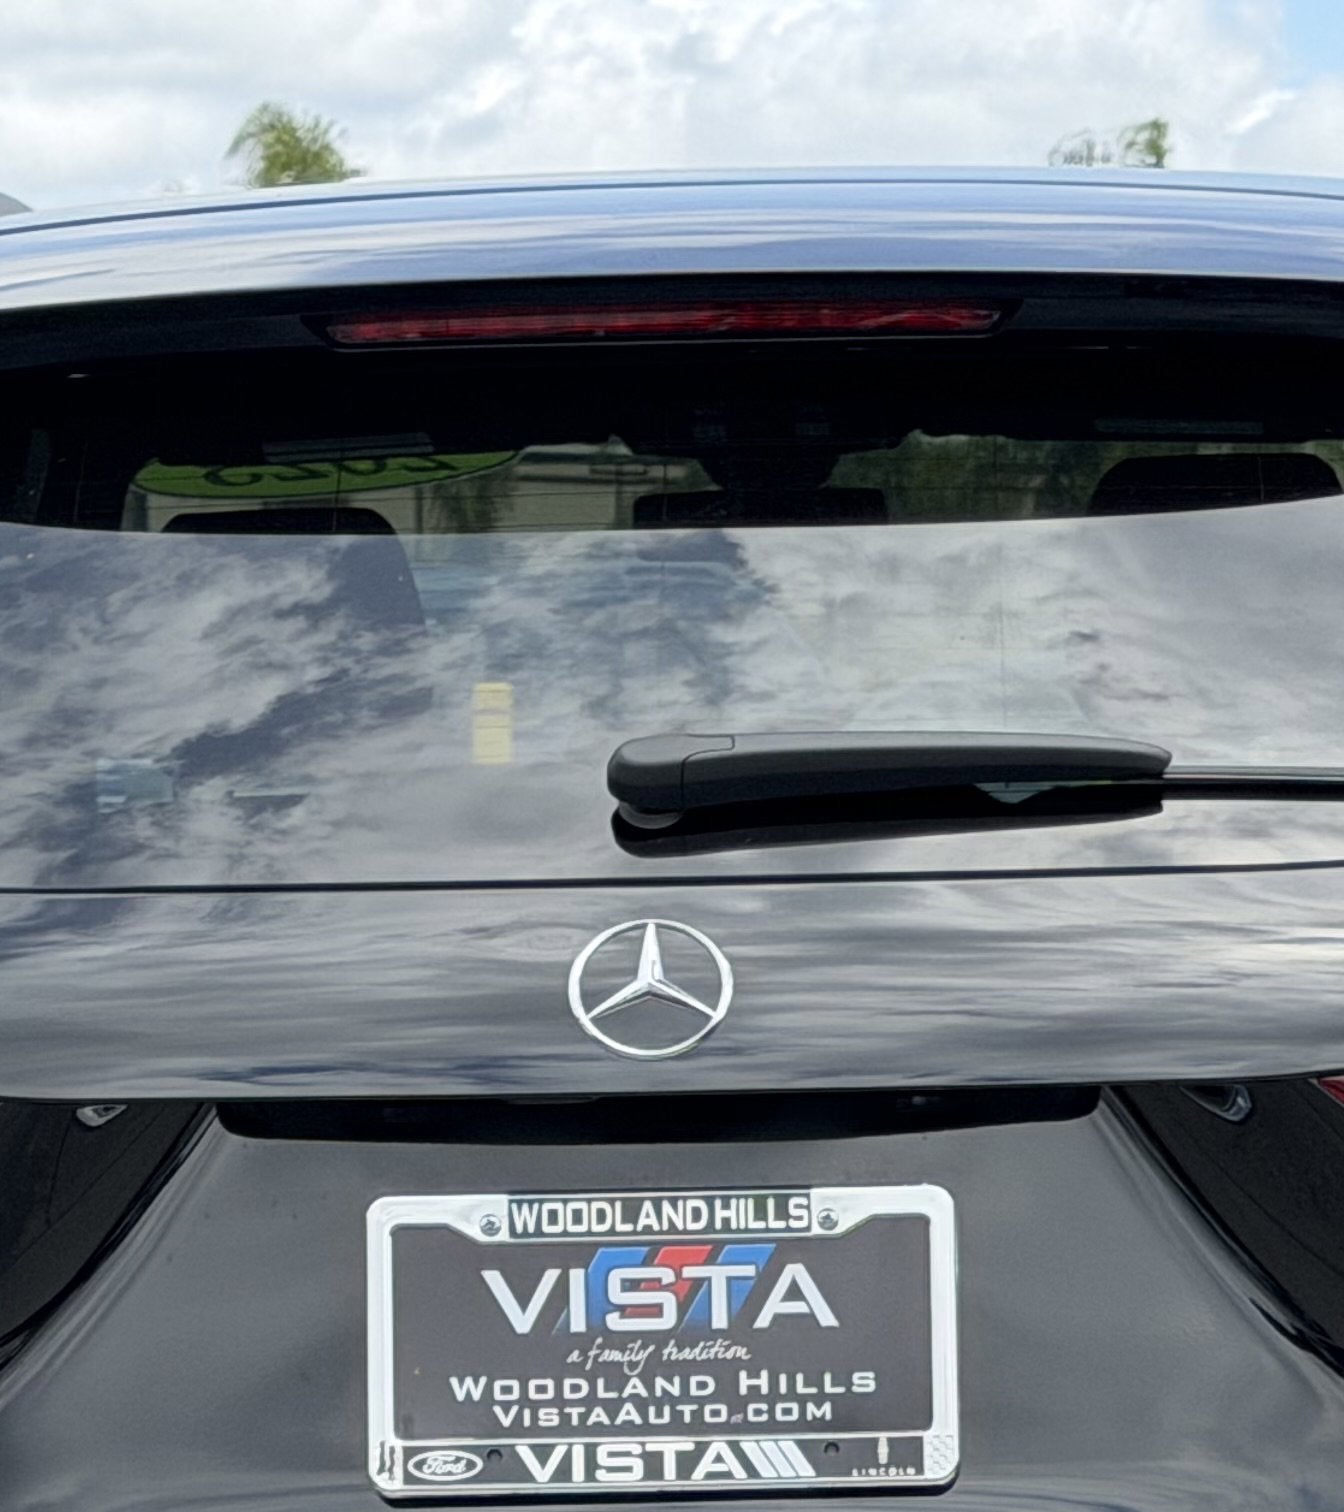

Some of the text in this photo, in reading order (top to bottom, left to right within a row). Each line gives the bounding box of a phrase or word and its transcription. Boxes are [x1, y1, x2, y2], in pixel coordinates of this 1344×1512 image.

[510, 1196, 809, 1235] WOODLAND HILLS
[480, 1263, 840, 1335] VISTA
[565, 1336, 753, 1377] a family tradition
[449, 1369, 877, 1402] WOODLAND HILLS
[422, 1455, 468, 1475] Ford
[515, 1440, 748, 1483] VISTA
